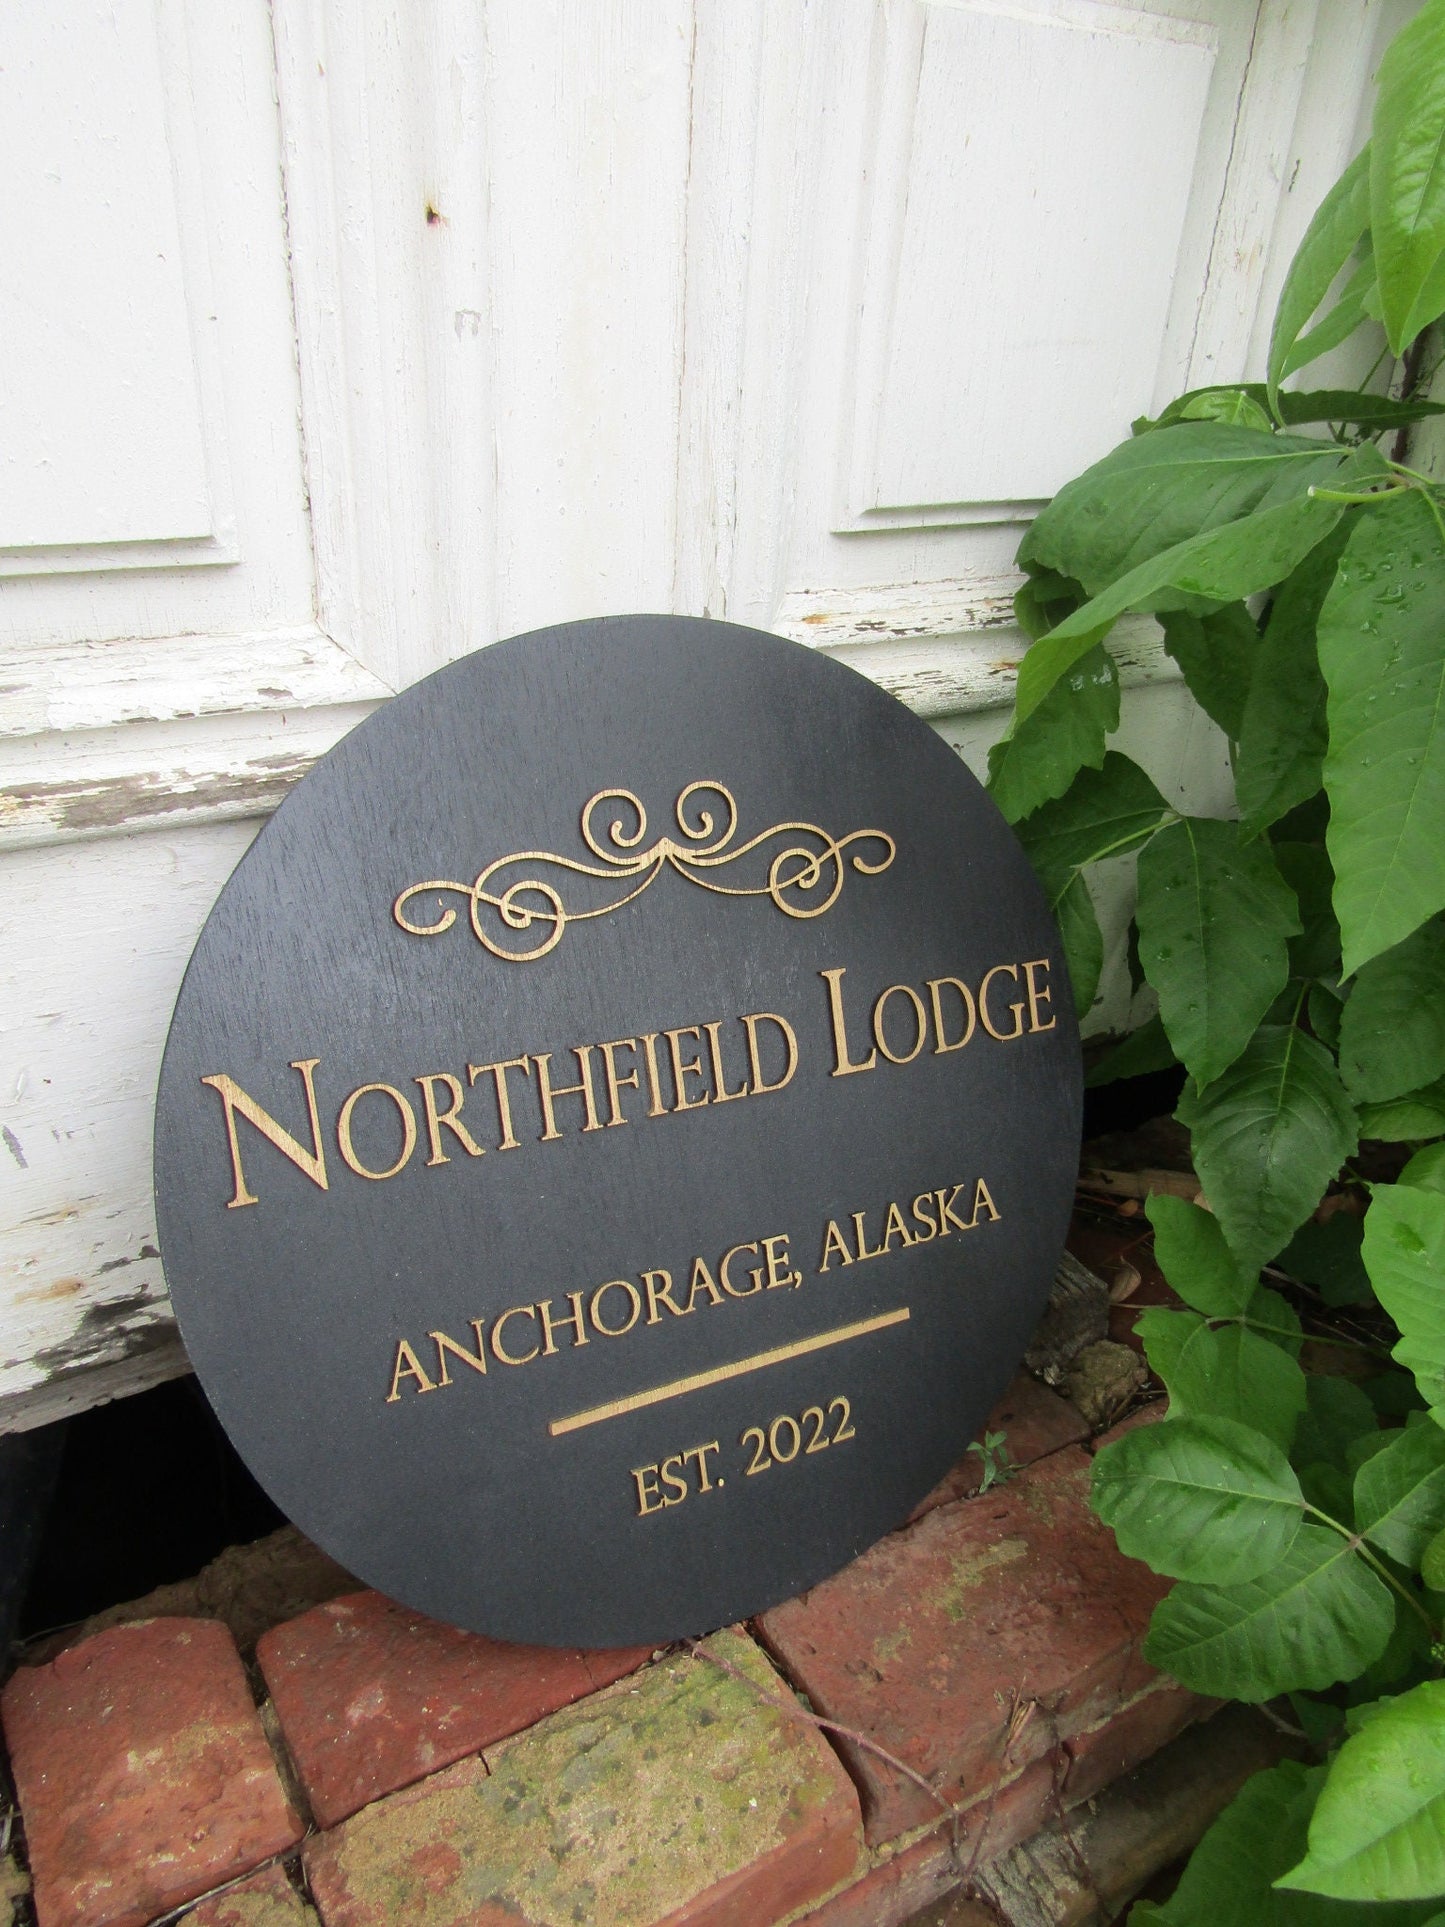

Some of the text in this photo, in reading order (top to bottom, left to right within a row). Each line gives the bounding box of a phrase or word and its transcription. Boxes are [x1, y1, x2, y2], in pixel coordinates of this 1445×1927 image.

[385, 1177, 1002, 1403] ANCHORAGE, ALASKA
[631, 1396, 856, 1517] EST. 2022
